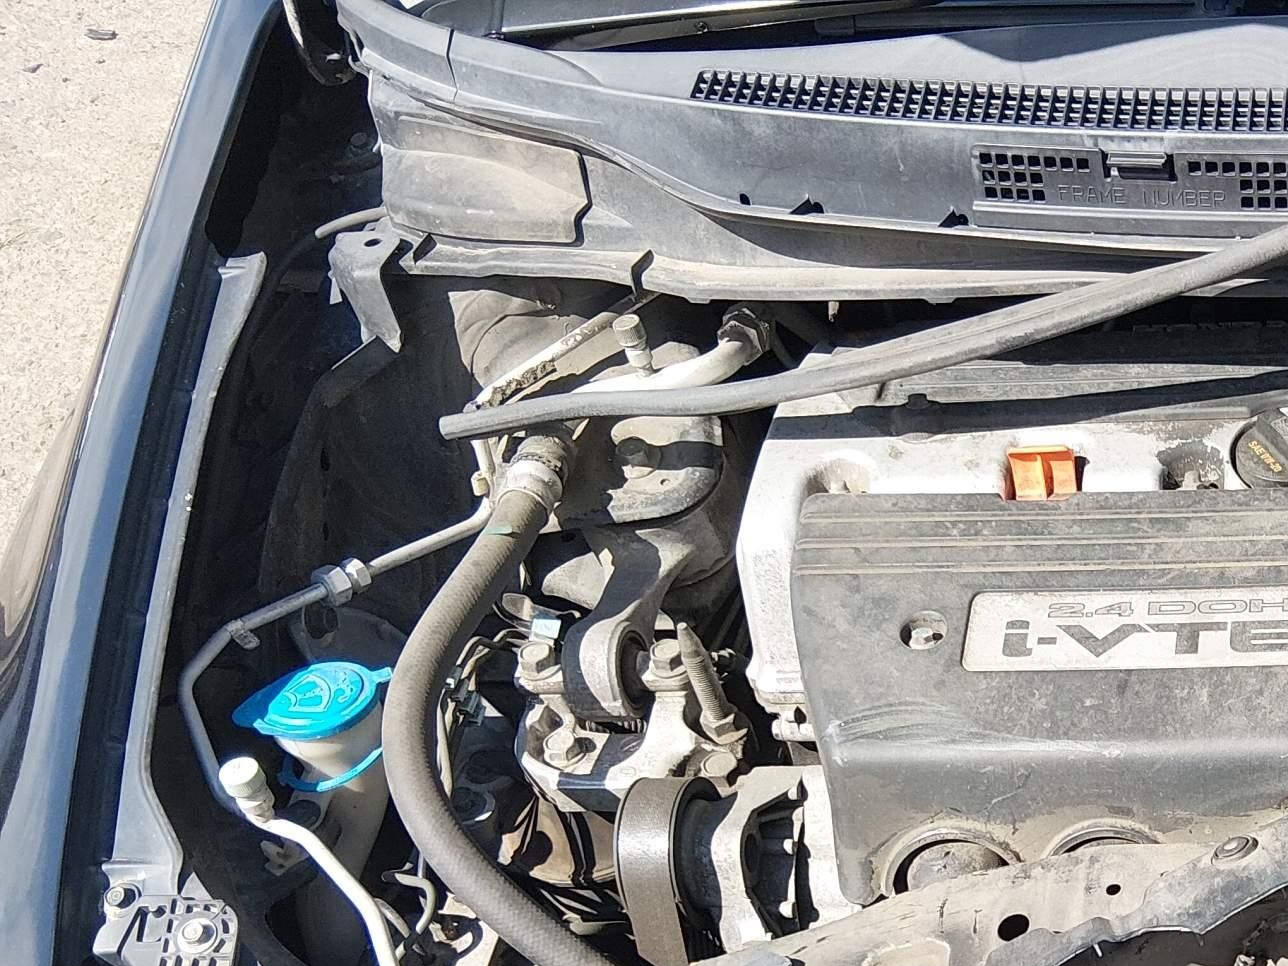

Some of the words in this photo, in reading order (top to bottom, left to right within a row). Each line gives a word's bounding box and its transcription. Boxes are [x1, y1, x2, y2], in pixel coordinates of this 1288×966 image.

[1057, 184, 1127, 205] FRAME
[1142, 188, 1226, 208] NUMBER
[1248, 440, 1266, 456] SAE
[1048, 602, 1134, 618] 2.4
